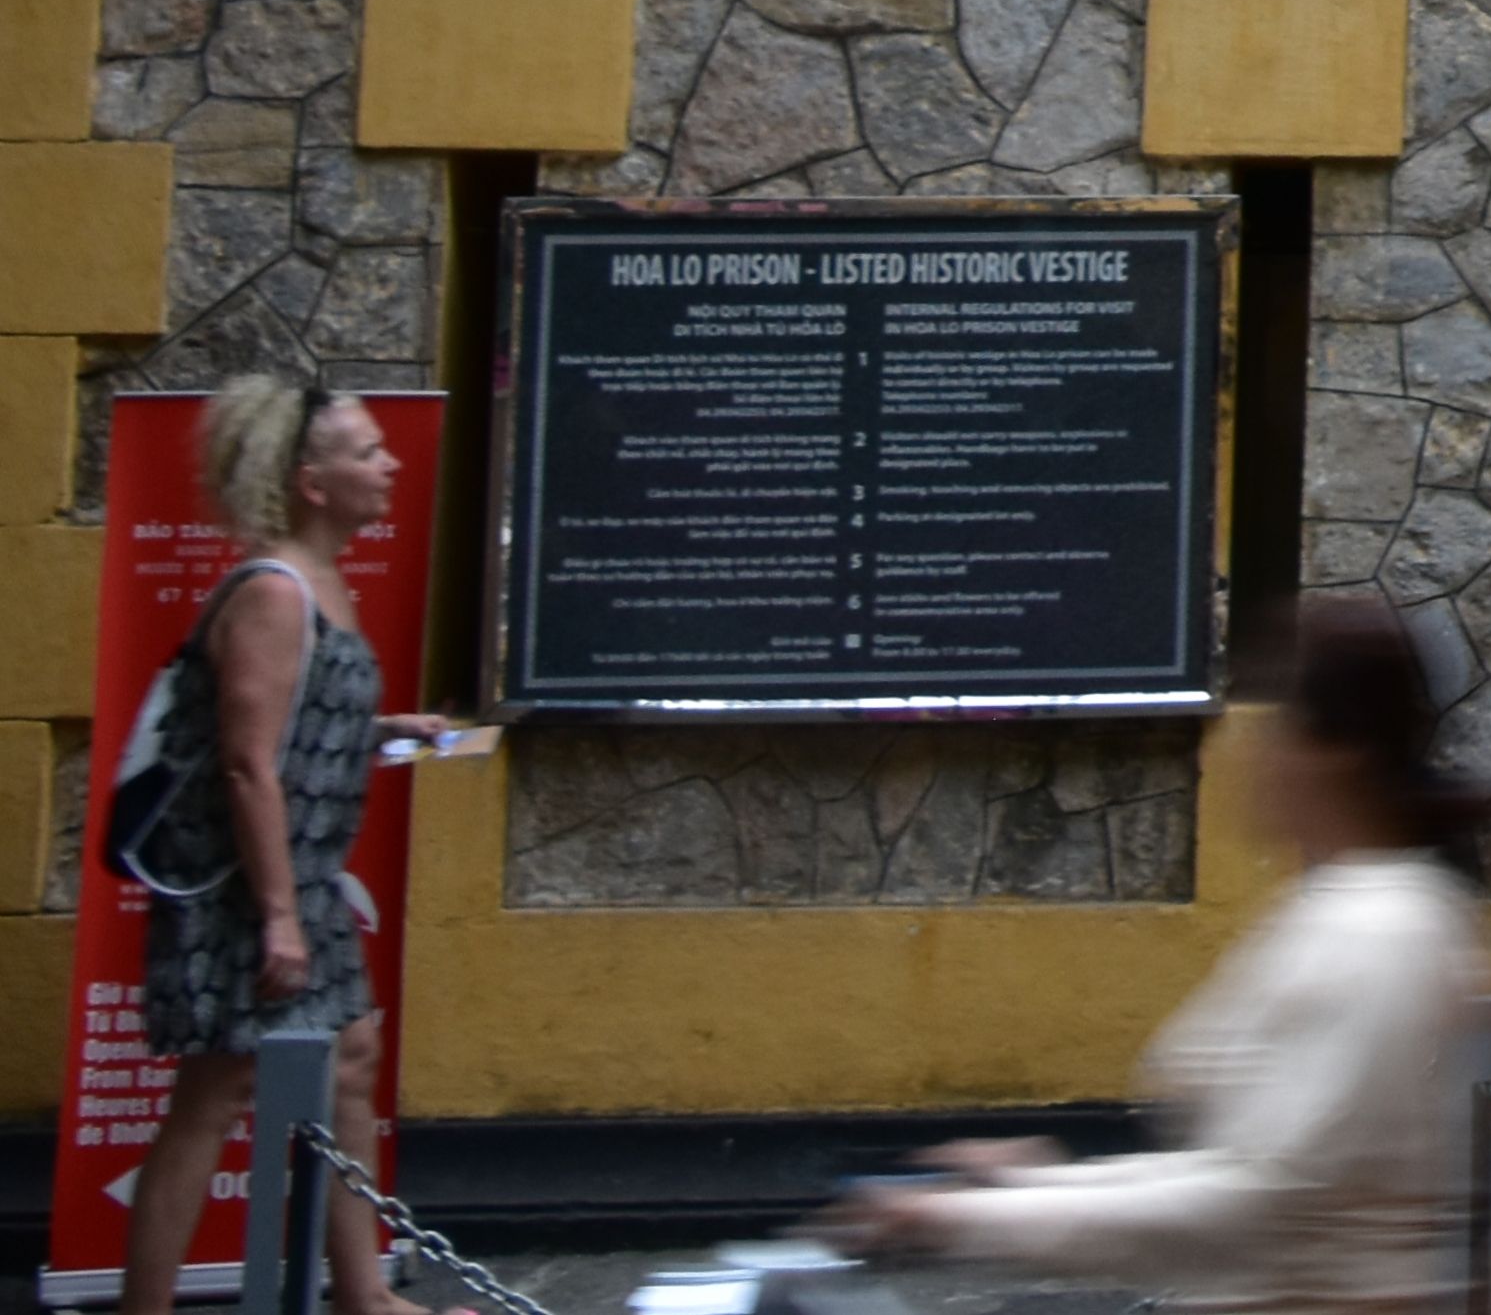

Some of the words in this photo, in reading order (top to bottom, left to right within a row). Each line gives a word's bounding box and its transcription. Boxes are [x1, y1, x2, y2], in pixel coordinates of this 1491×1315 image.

[611, 254, 665, 286] HOA
[671, 254, 701, 286] LO
[707, 253, 801, 285] PRISON
[821, 252, 905, 284] LISTED
[910, 252, 1025, 284] HISTORIC
[1028, 250, 1129, 282] VESTIGE
[719, 304, 751, 319] QUY
[756, 303, 799, 318] THAM
[801, 303, 847, 318] QUAN
[884, 303, 957, 317] INTERNAL
[959, 302, 1063, 316] REGULATIONS
[1065, 302, 1095, 315] FOR
[1098, 301, 1135, 315] VISIT
[884, 322, 900, 335] IN
[903, 322, 937, 335] HOA
[940, 322, 960, 335] LO
[962, 321, 1016, 334] PRISON
[1018, 320, 1081, 334] VESTIGE
[858, 352, 868, 367] 1
[853, 432, 867, 447] 2
[853, 485, 866, 501] 3
[850, 514, 864, 528] 4
[849, 553, 863, 569] 5
[847, 596, 861, 610] 6
